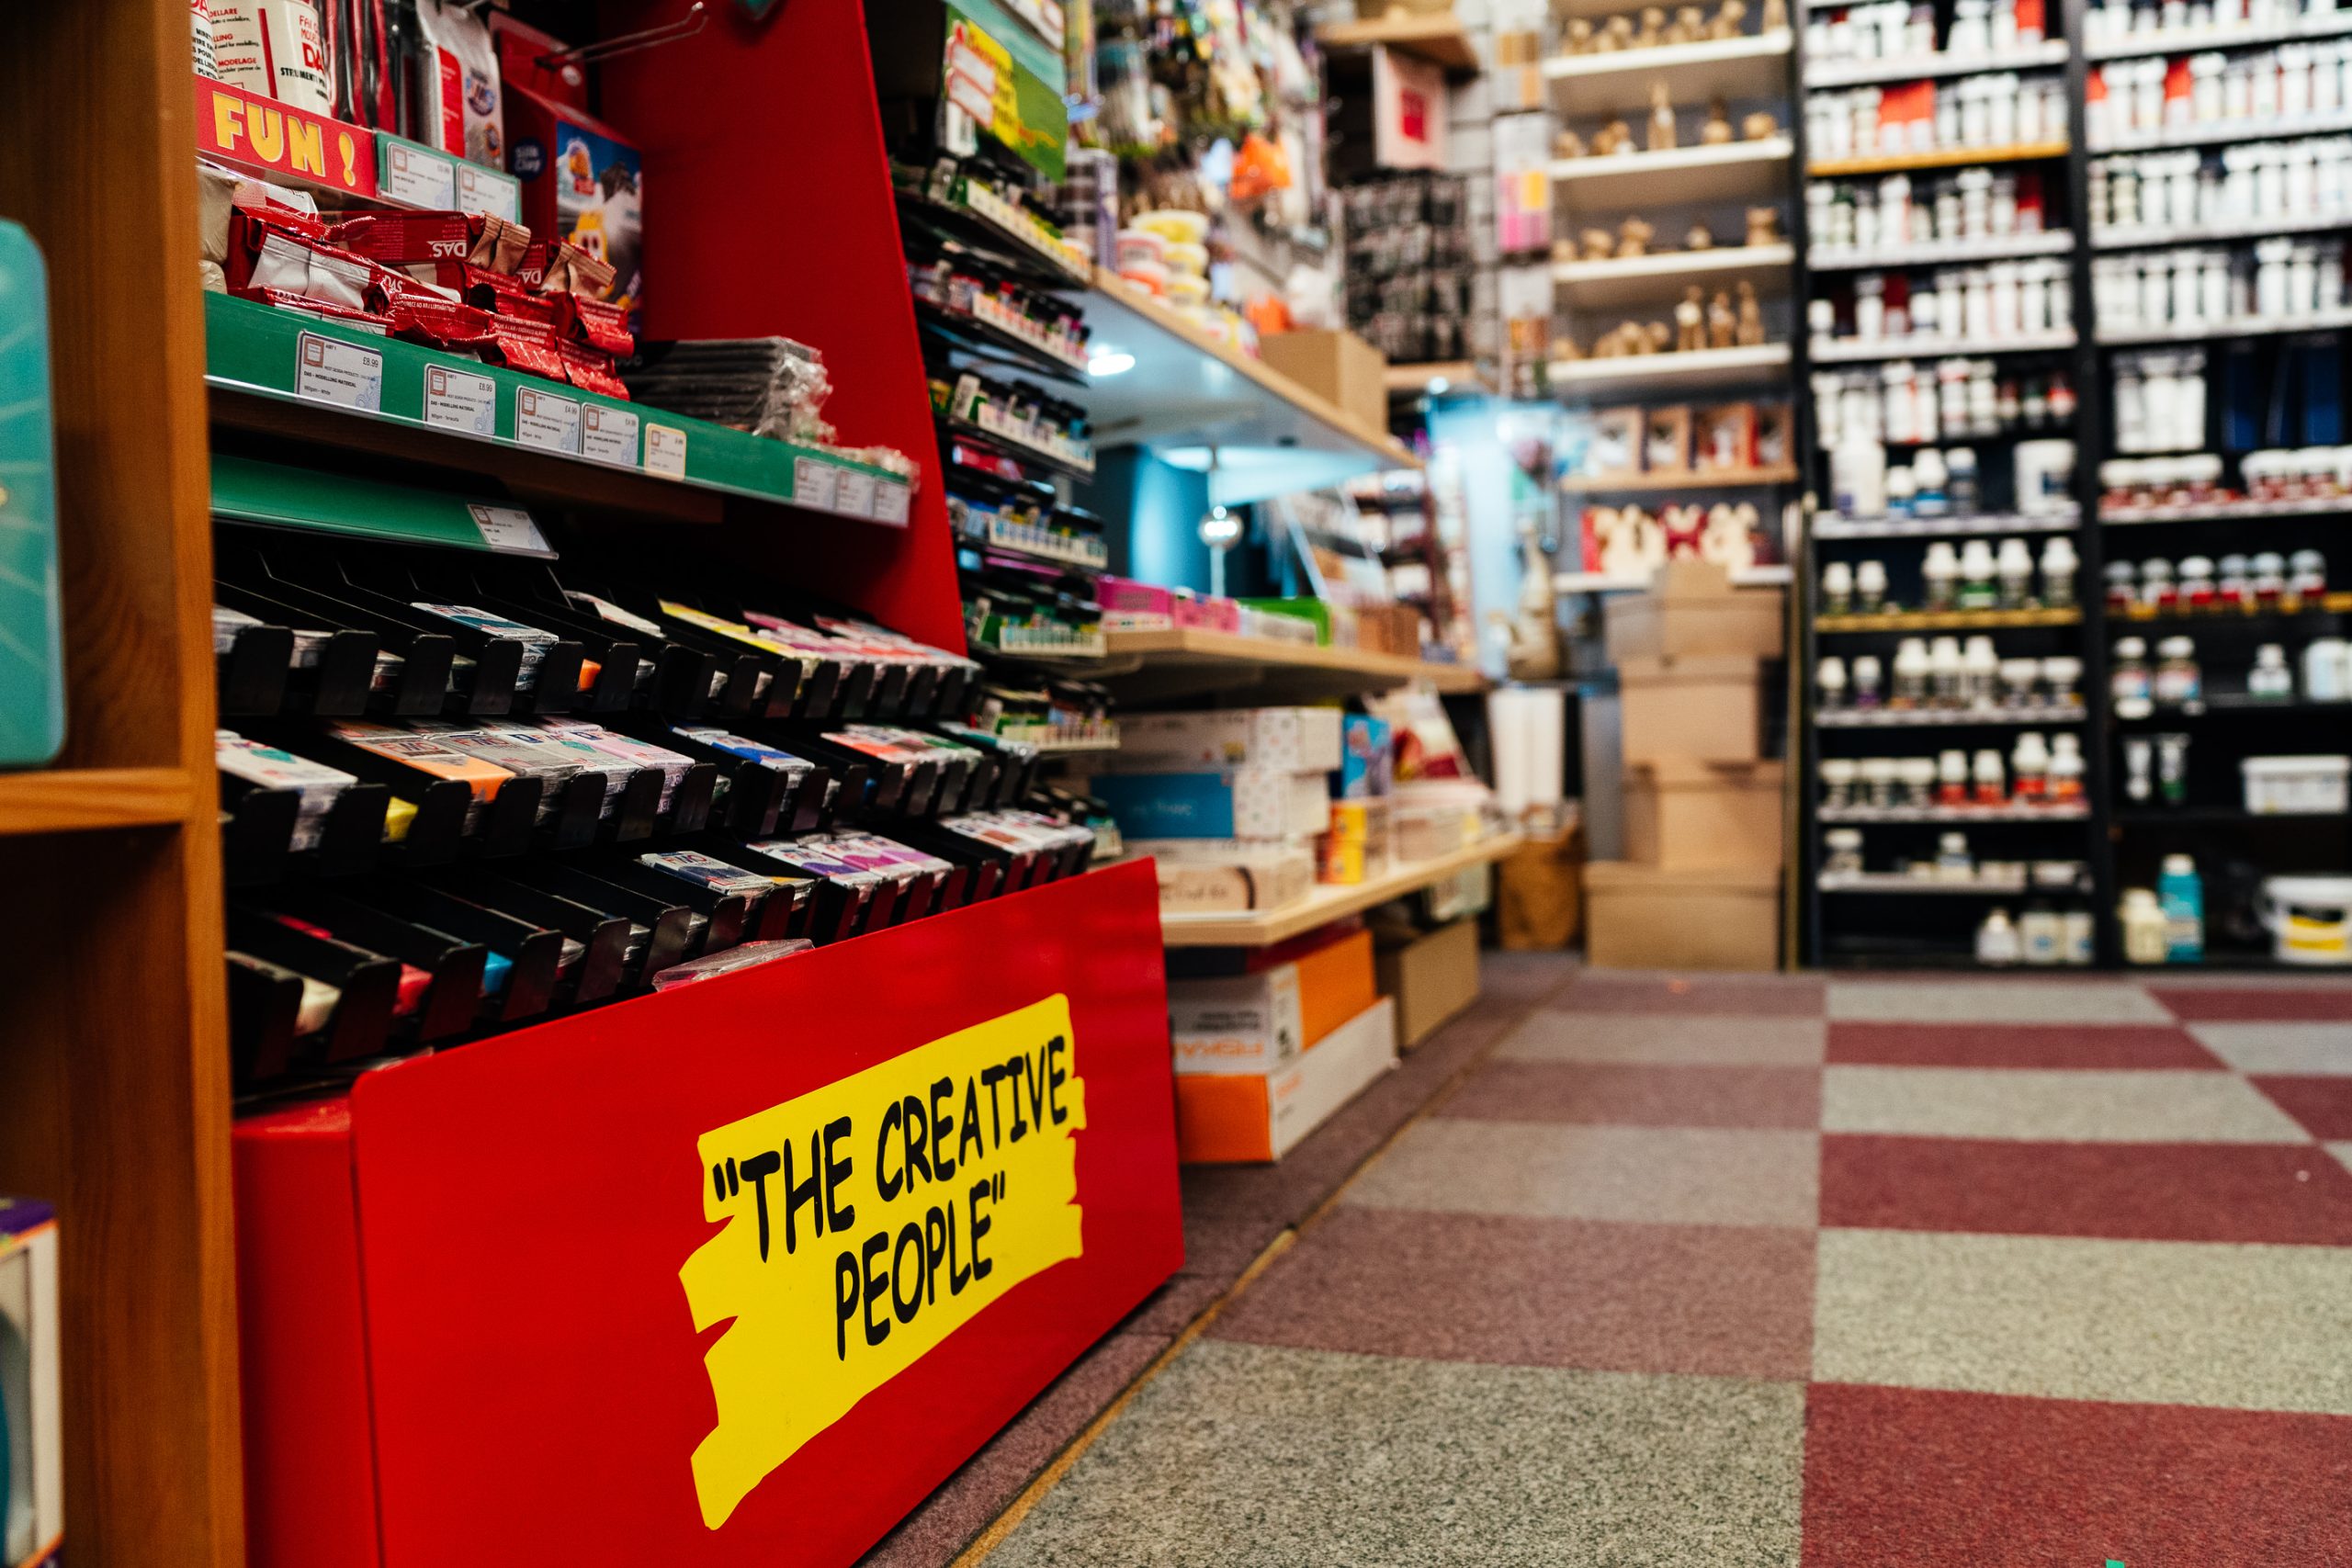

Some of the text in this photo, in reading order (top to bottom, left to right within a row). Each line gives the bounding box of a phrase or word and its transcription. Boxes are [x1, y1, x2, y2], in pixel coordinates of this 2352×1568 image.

[212, 90, 326, 177] FUN
[432, 242, 467, 257] DAS
[480, 382, 492, 392] £8.99
[662, 854, 707, 864] FIMO
[712, 1034, 1069, 1264] "THE CREATIVE
[834, 1170, 1006, 1362] PEOPLE"
